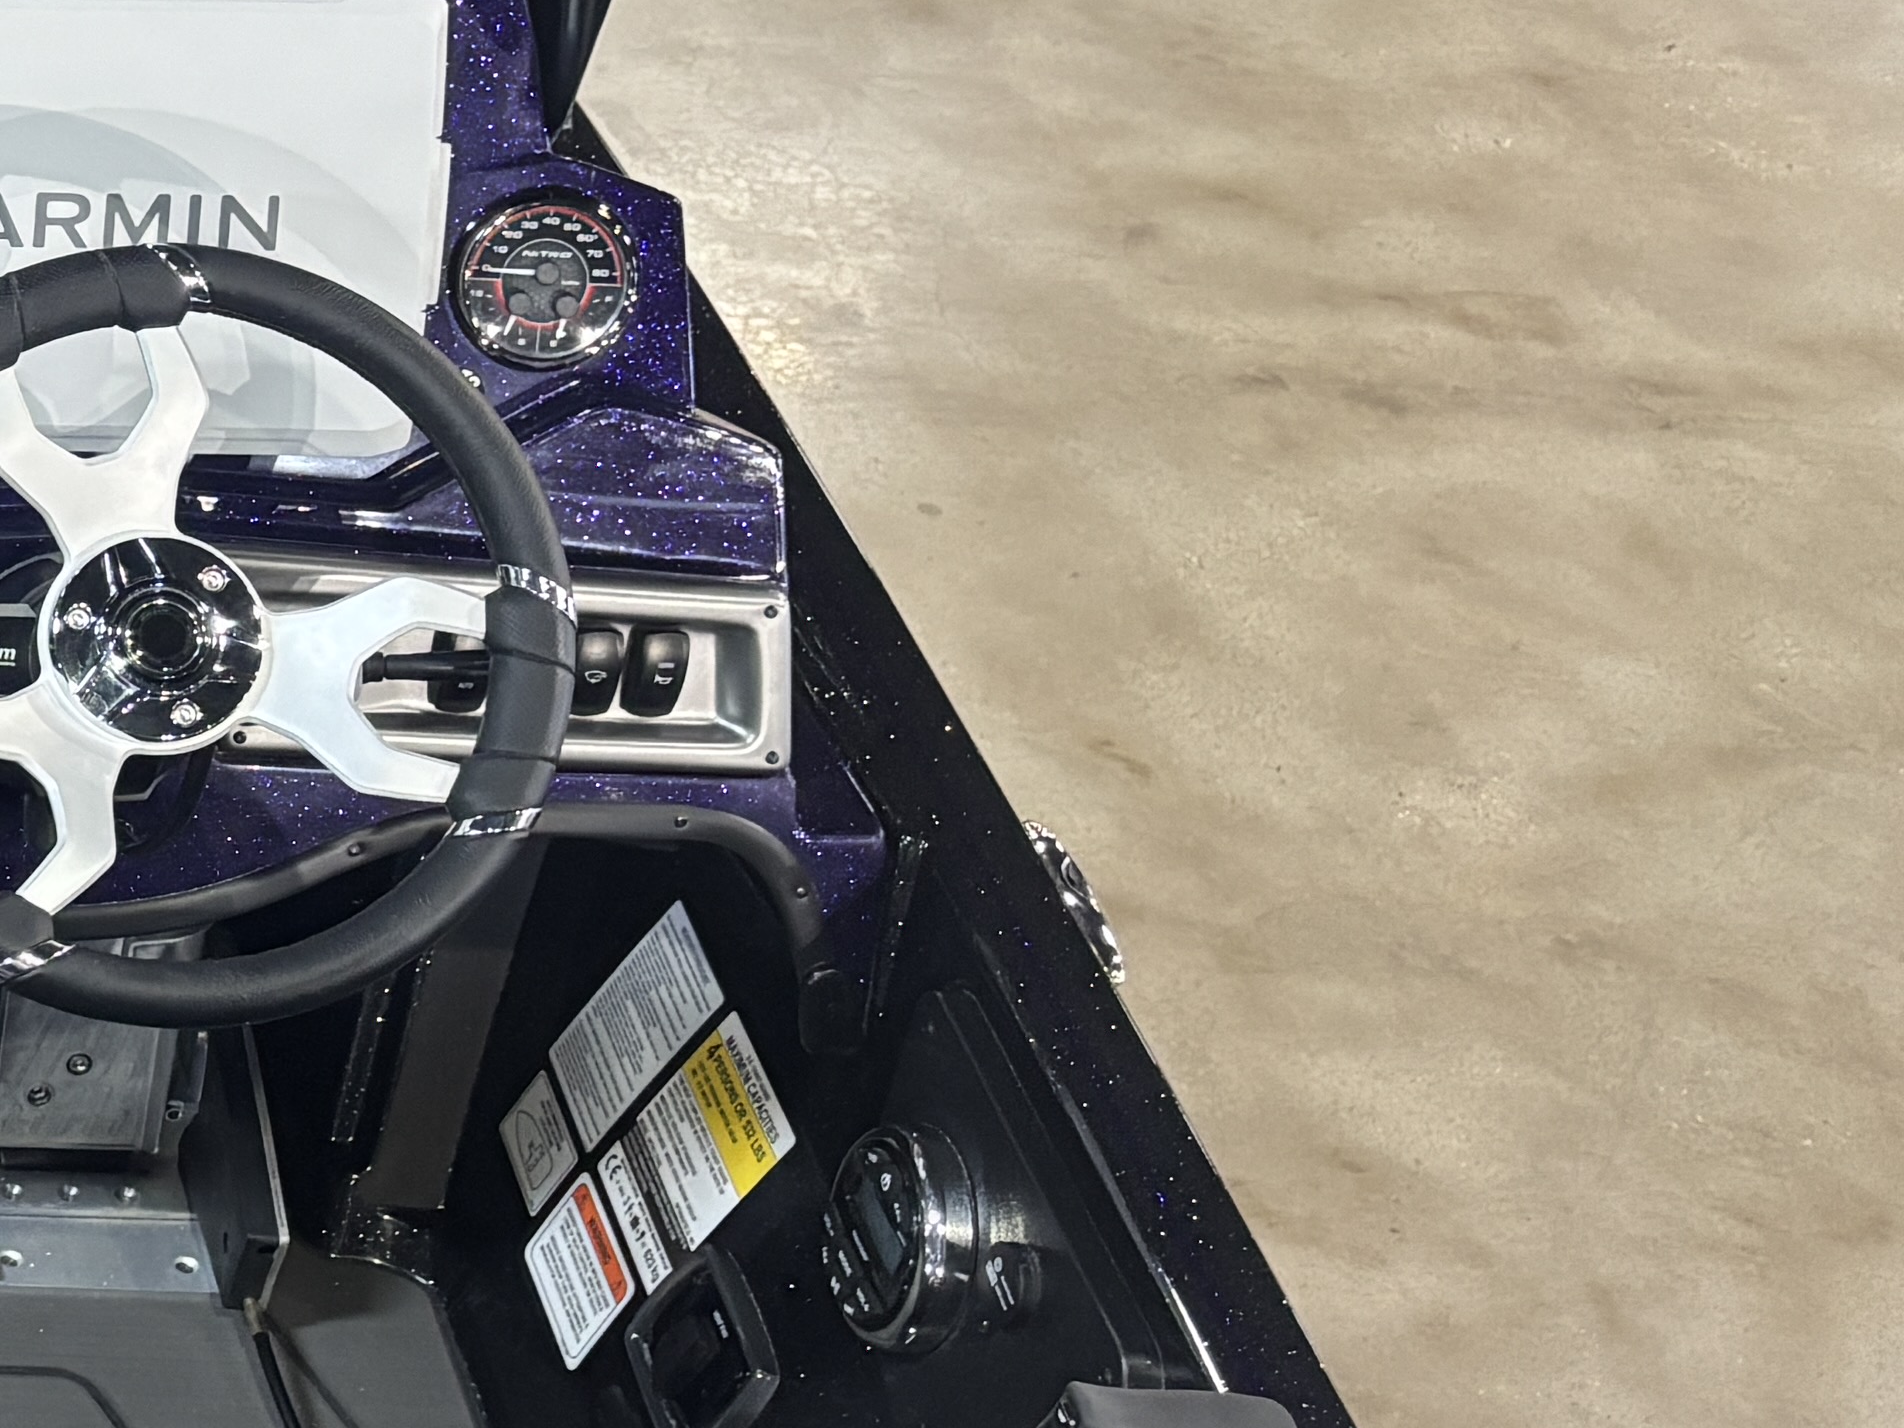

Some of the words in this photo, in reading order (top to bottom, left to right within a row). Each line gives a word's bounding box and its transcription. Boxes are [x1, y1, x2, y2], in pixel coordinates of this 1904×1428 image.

[703, 1037, 723, 1062] 4
[732, 1098, 748, 1123] OR
[748, 1135, 768, 1165] LBS
[743, 1079, 782, 1146] CAPACITIES
